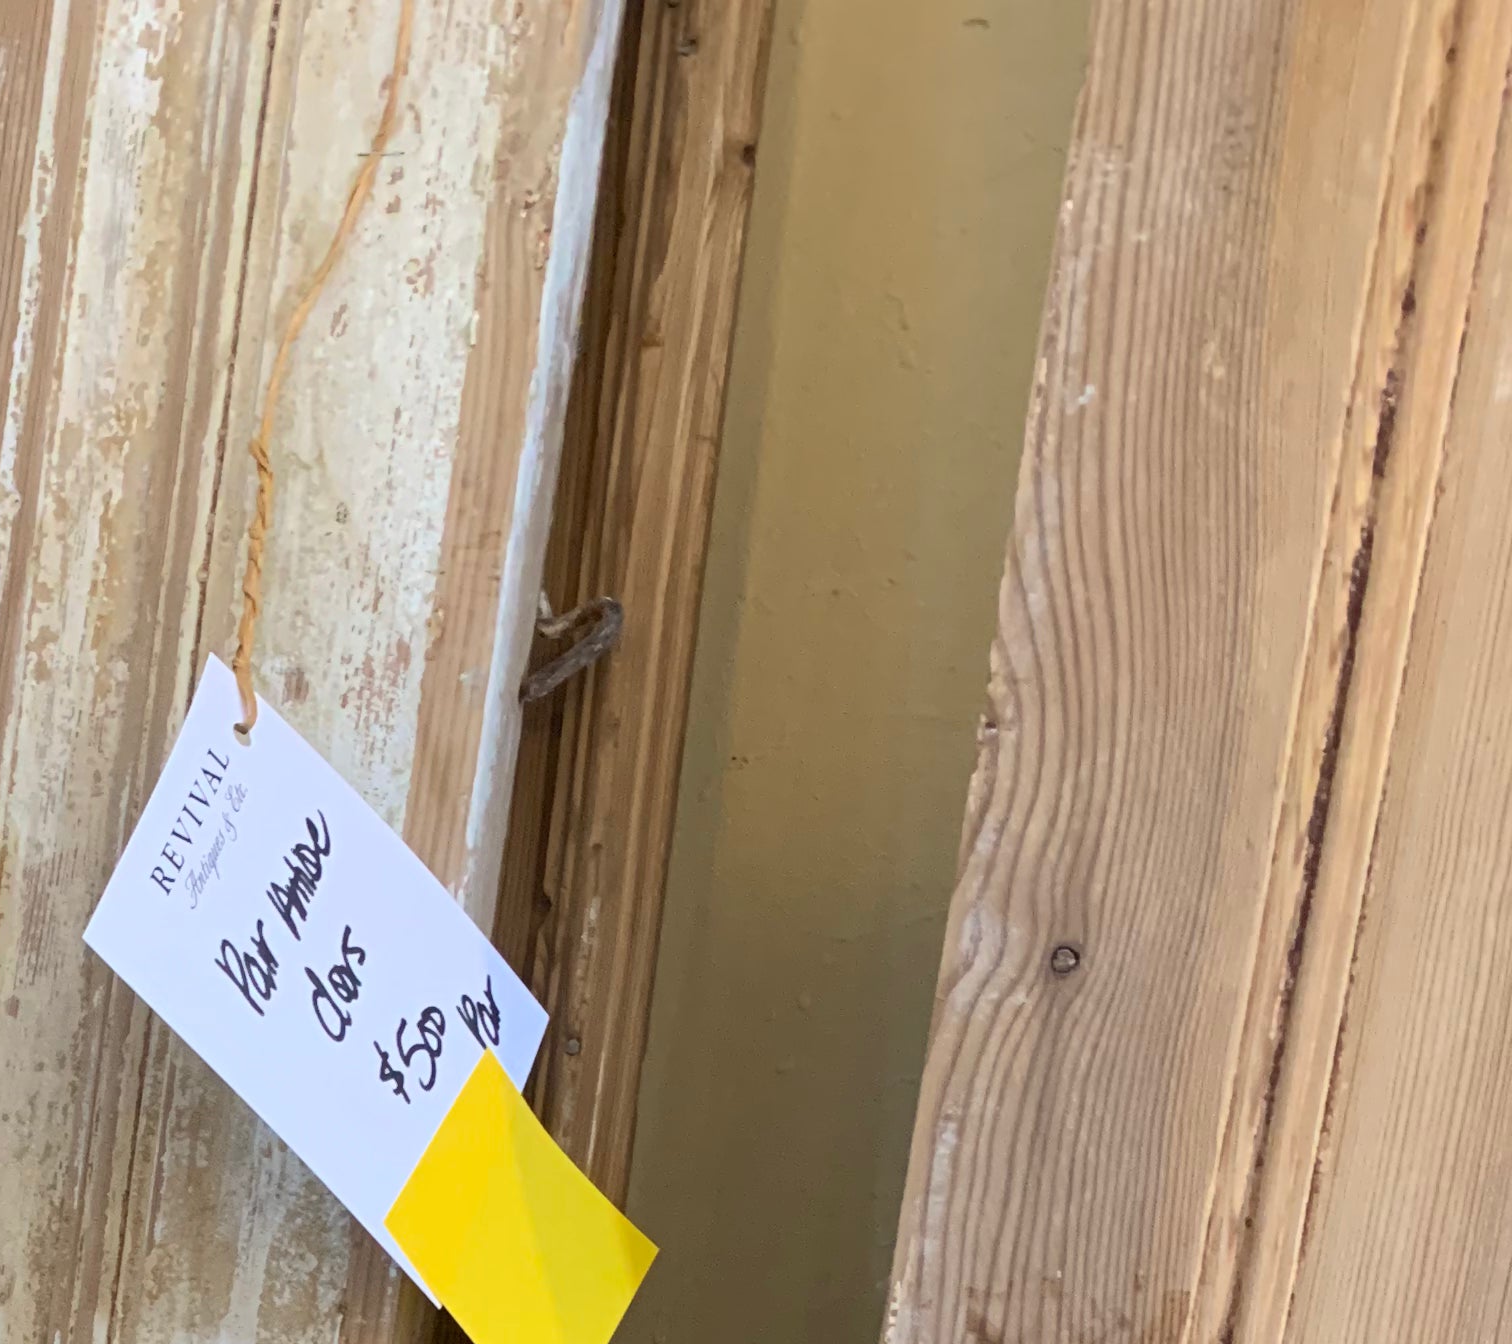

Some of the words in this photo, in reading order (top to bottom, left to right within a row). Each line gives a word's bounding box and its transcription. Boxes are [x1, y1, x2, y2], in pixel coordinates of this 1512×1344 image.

[150, 748, 229, 894] REVIVAL
[185, 828, 227, 909] Antiques
[374, 1006, 445, 1104] $500
